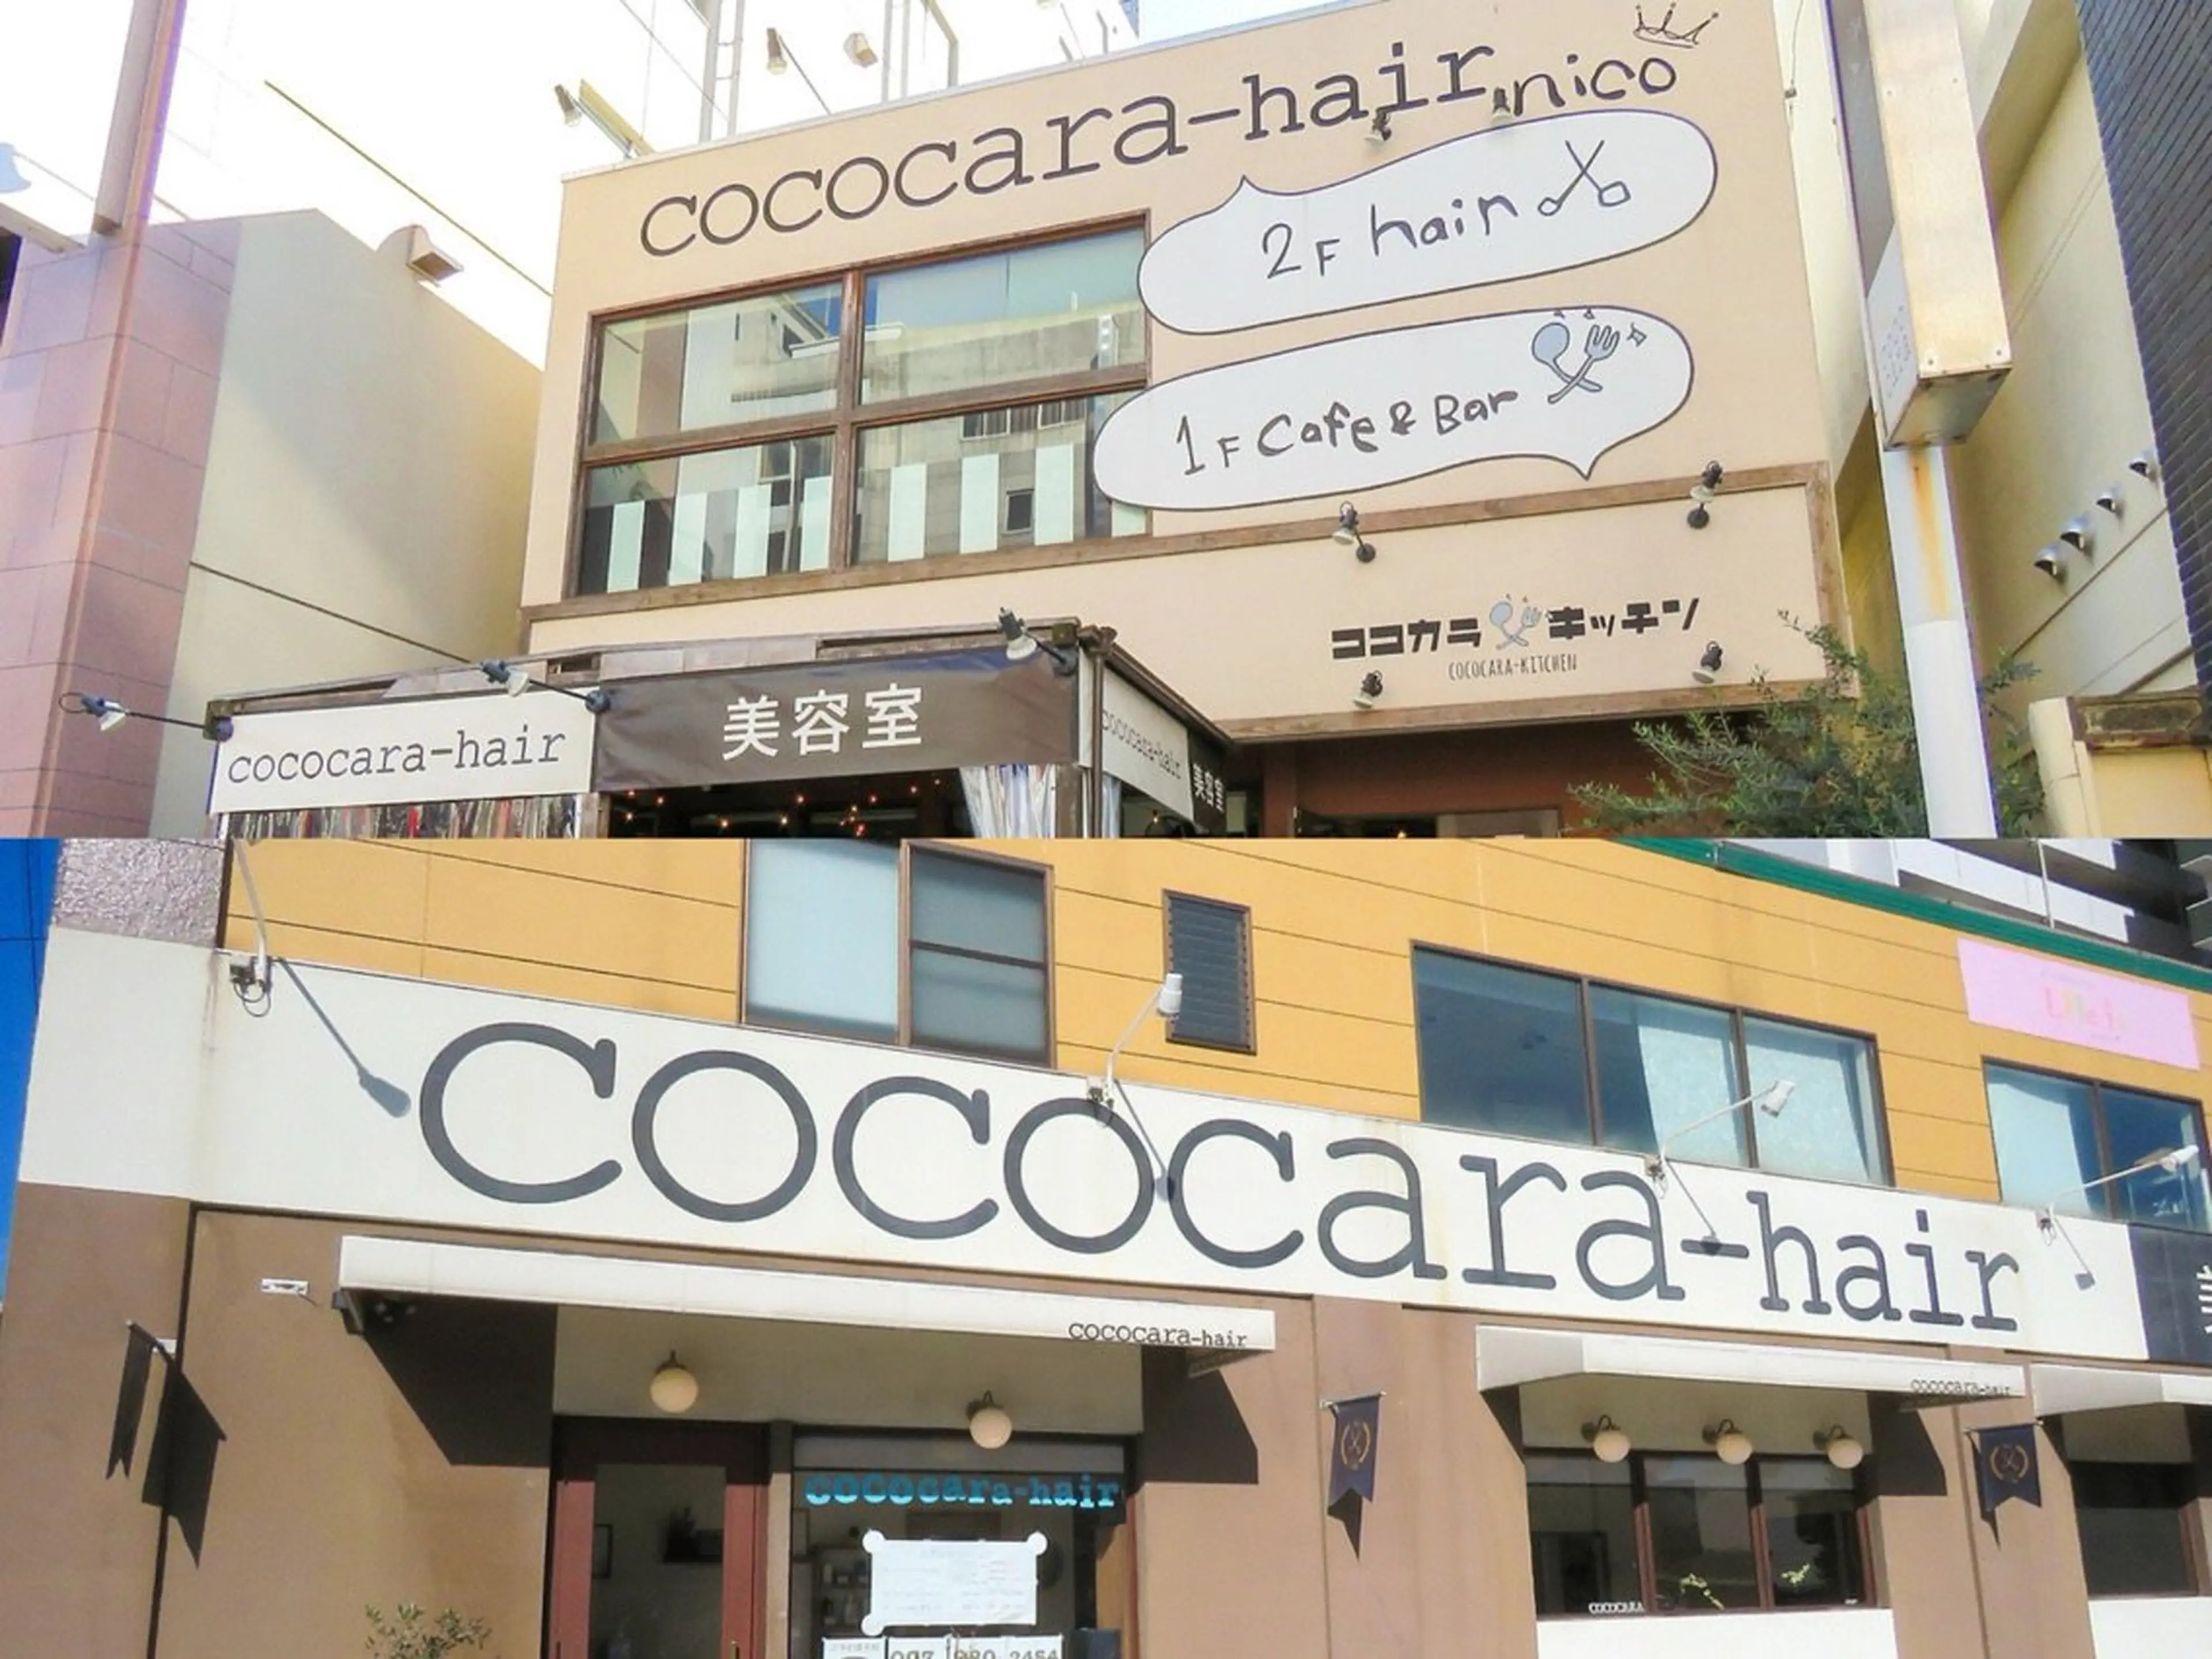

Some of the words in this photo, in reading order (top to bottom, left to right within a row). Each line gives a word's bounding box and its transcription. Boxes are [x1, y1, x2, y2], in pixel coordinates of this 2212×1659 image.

[640, 41, 1494, 257] cococara-hair
[1513, 54, 1677, 116] nico
[1262, 222, 1340, 279] 2F
[1372, 196, 1518, 258] hair
[1176, 415, 1241, 476] 1F
[1332, 618, 1482, 659] ココカラ
[1548, 597, 1700, 639] キッチン
[1448, 653, 1577, 681] COCOCARA-KITCHEN
[722, 683, 922, 762] 美容室
[228, 724, 566, 784] cococara-hair
[419, 1021, 2019, 1331] cococara-hair
[1069, 1323, 1248, 1347] cococara-hair
